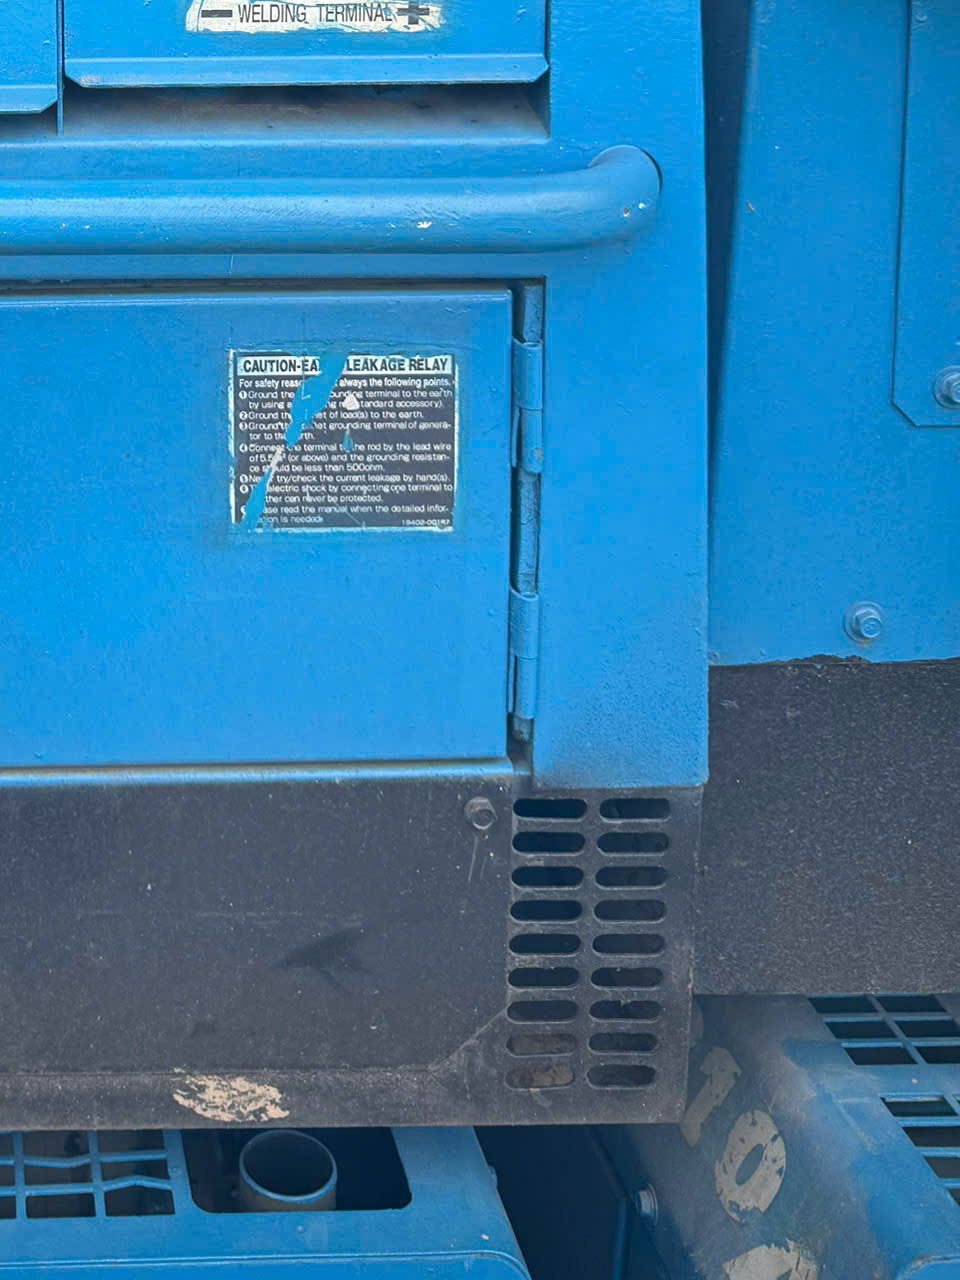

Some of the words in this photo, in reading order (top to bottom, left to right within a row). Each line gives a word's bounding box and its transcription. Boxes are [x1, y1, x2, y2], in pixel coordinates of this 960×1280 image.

[238, 3, 307, 23] WELDING
[316, 3, 393, 22] TERMINAL
[346, 359, 406, 371] LEAKAGE
[409, 358, 448, 371] RELAY
[239, 378, 253, 387] For
[255, 378, 279, 389] safety
[339, 377, 367, 388] always
[369, 377, 382, 387] the
[384, 377, 421, 388] following
[423, 377, 451, 388] points.
[248, 391, 278, 399] Ground
[280, 391, 294, 399] the
[365, 390, 400, 398] terminal
[414, 390, 427, 398] the
[429, 389, 453, 398] earth
[261, 401, 284, 409] using
[248, 411, 279, 419] Ground
[340, 411, 368, 419] load(s)
[382, 411, 396, 419] the
[398, 410, 424, 419] earth.
[248, 422, 279, 430] Ground
[329, 421, 371, 430] grounding
[373, 421, 406, 429] terminal
[303, 443, 337, 452] terminal
[367, 442, 381, 451] rod
[396, 442, 410, 451] the
[413, 442, 430, 451] lead
[433, 442, 452, 451] wire
[331, 453, 347, 461] and
[350, 453, 364, 461] the
[366, 453, 410, 462] grounding
[304, 464, 322, 472] less
[325, 464, 344, 472] than
[276, 474, 317, 483] try/check
[320, 474, 333, 482] the
[336, 474, 366, 482] current
[368, 473, 401, 482] leakage
[301, 484, 326, 493] shock
[341, 483, 389, 493] connecting
[408, 483, 441, 492] terminal
[302, 495, 325, 503] never
[280, 506, 299, 514] read
[301, 505, 316, 514] the
[318, 505, 347, 513] manual
[350, 504, 372, 513] when
[375, 504, 389, 513] the
[391, 504, 425, 513] detailed
